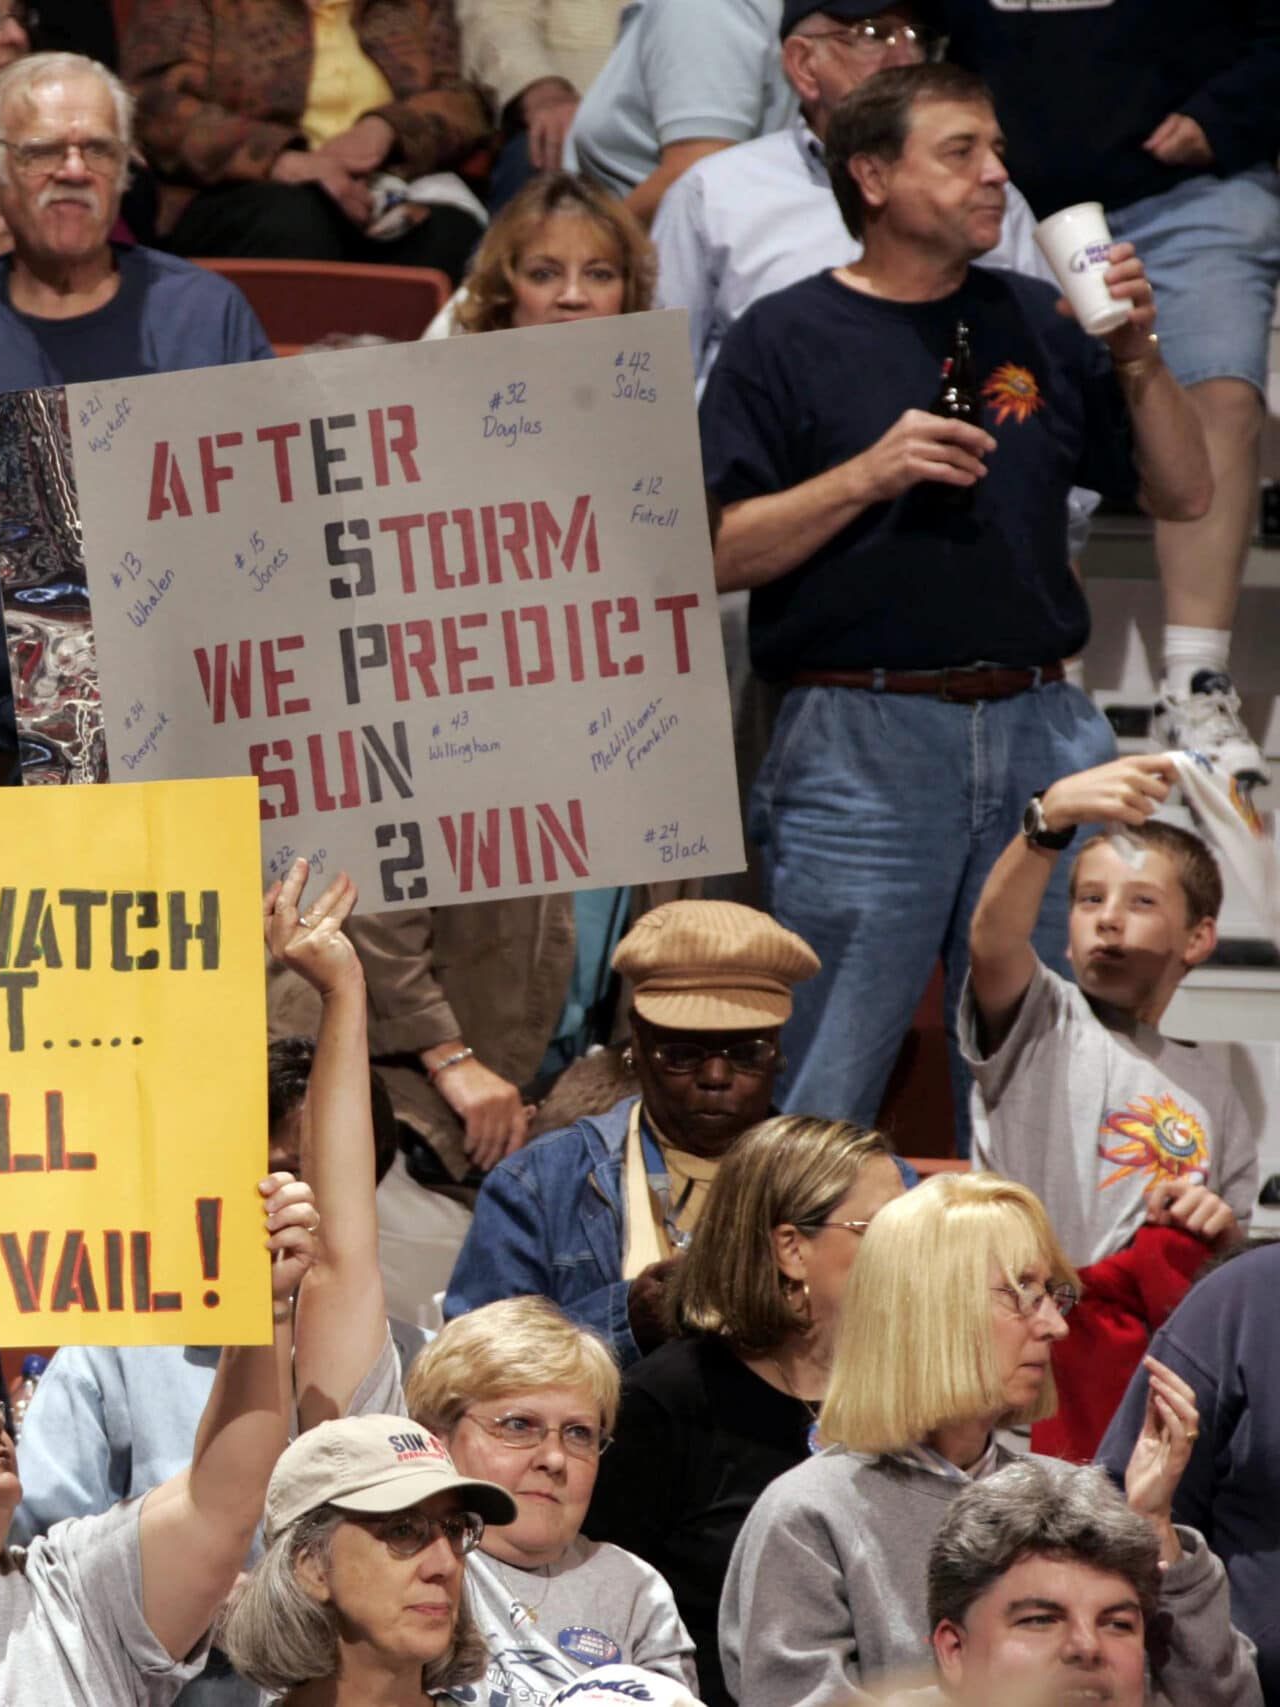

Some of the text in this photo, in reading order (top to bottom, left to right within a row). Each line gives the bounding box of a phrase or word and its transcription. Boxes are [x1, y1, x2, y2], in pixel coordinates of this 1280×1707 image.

[615, 351, 651, 377] #42
[489, 382, 527, 412] #32
[613, 374, 657, 403] Sales
[80, 394, 103, 427] #21
[147, 405, 421, 521] AFTER
[631, 476, 663, 496] #12
[324, 495, 601, 600] STORM
[111, 551, 142, 588] #13
[249, 548, 288, 592] Jones
[127, 568, 175, 627] Whalen
[194, 594, 700, 724] WE PREDICT
[588, 706, 612, 737] #11
[429, 736, 502, 764] Willingham
[627, 714, 679, 770] Franklin
[249, 721, 413, 820] SUN
[644, 821, 679, 843] #24
[659, 833, 710, 863] Black
[269, 846, 296, 873] #22
[376, 821, 429, 902] 2
[439, 799, 589, 893] WIN
